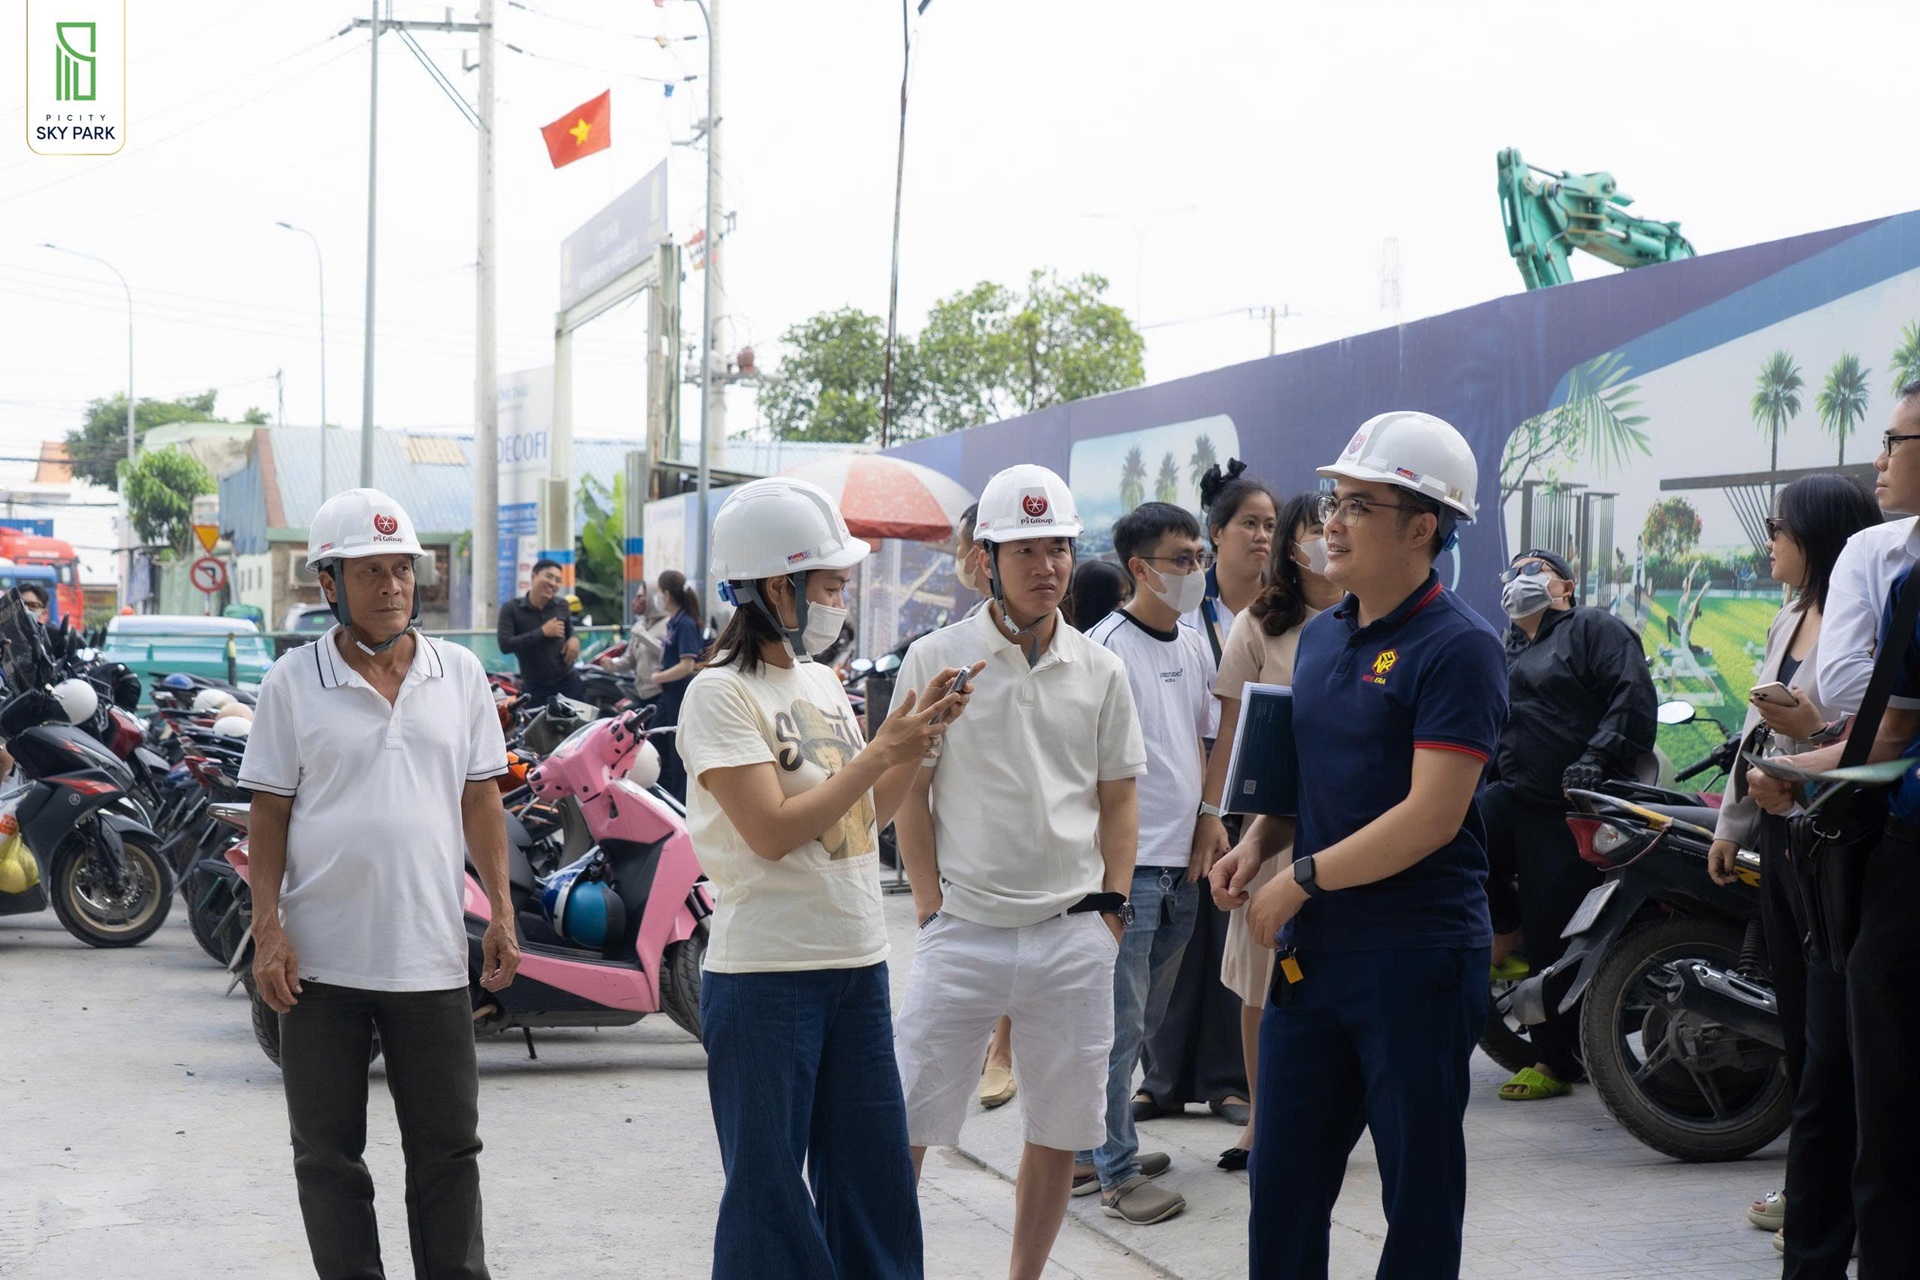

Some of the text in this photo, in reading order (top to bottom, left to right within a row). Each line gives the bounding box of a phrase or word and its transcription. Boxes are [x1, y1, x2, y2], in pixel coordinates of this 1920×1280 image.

[1030, 517, 1053, 525] Group
[382, 535, 404, 543] Group
[1374, 676, 1386, 685] ERA
